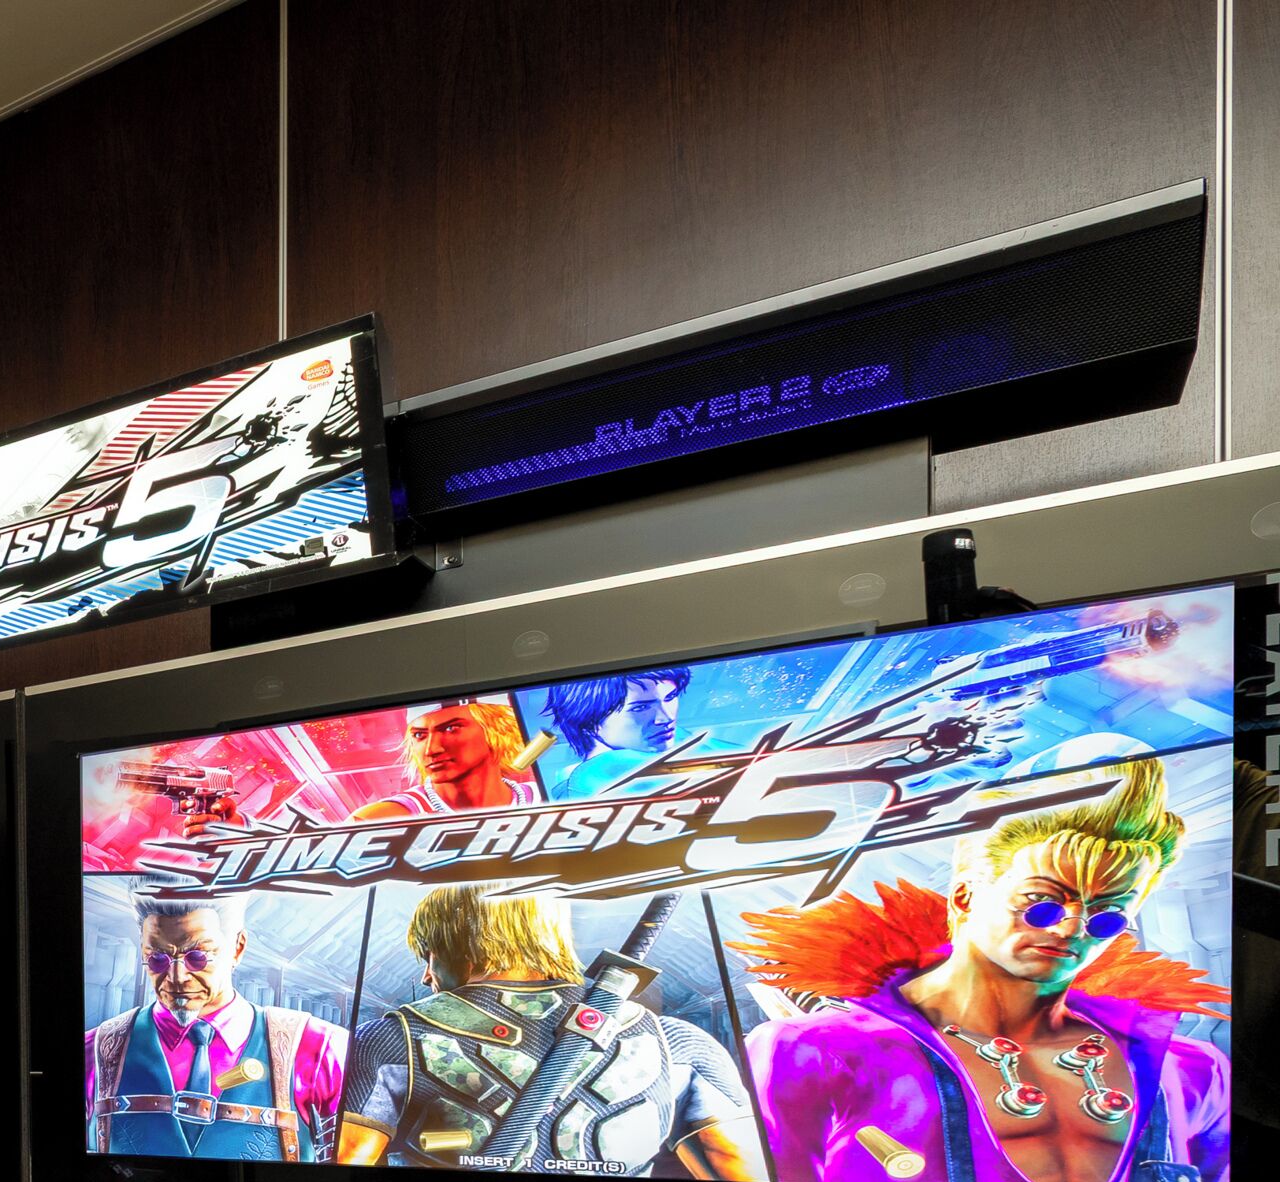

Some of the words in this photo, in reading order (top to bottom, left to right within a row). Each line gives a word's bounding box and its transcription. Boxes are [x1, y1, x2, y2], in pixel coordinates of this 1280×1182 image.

[595, 385, 771, 445] PLAYER
[780, 376, 811, 401] 2
[101, 438, 238, 569] 5
[217, 824, 396, 881] TIME
[405, 798, 700, 868] CRISIS
[685, 738, 918, 872] 5
[459, 1155, 514, 1168] INSERT
[525, 1158, 532, 1168] 1
[544, 1159, 625, 1173] CREDIT(S)
